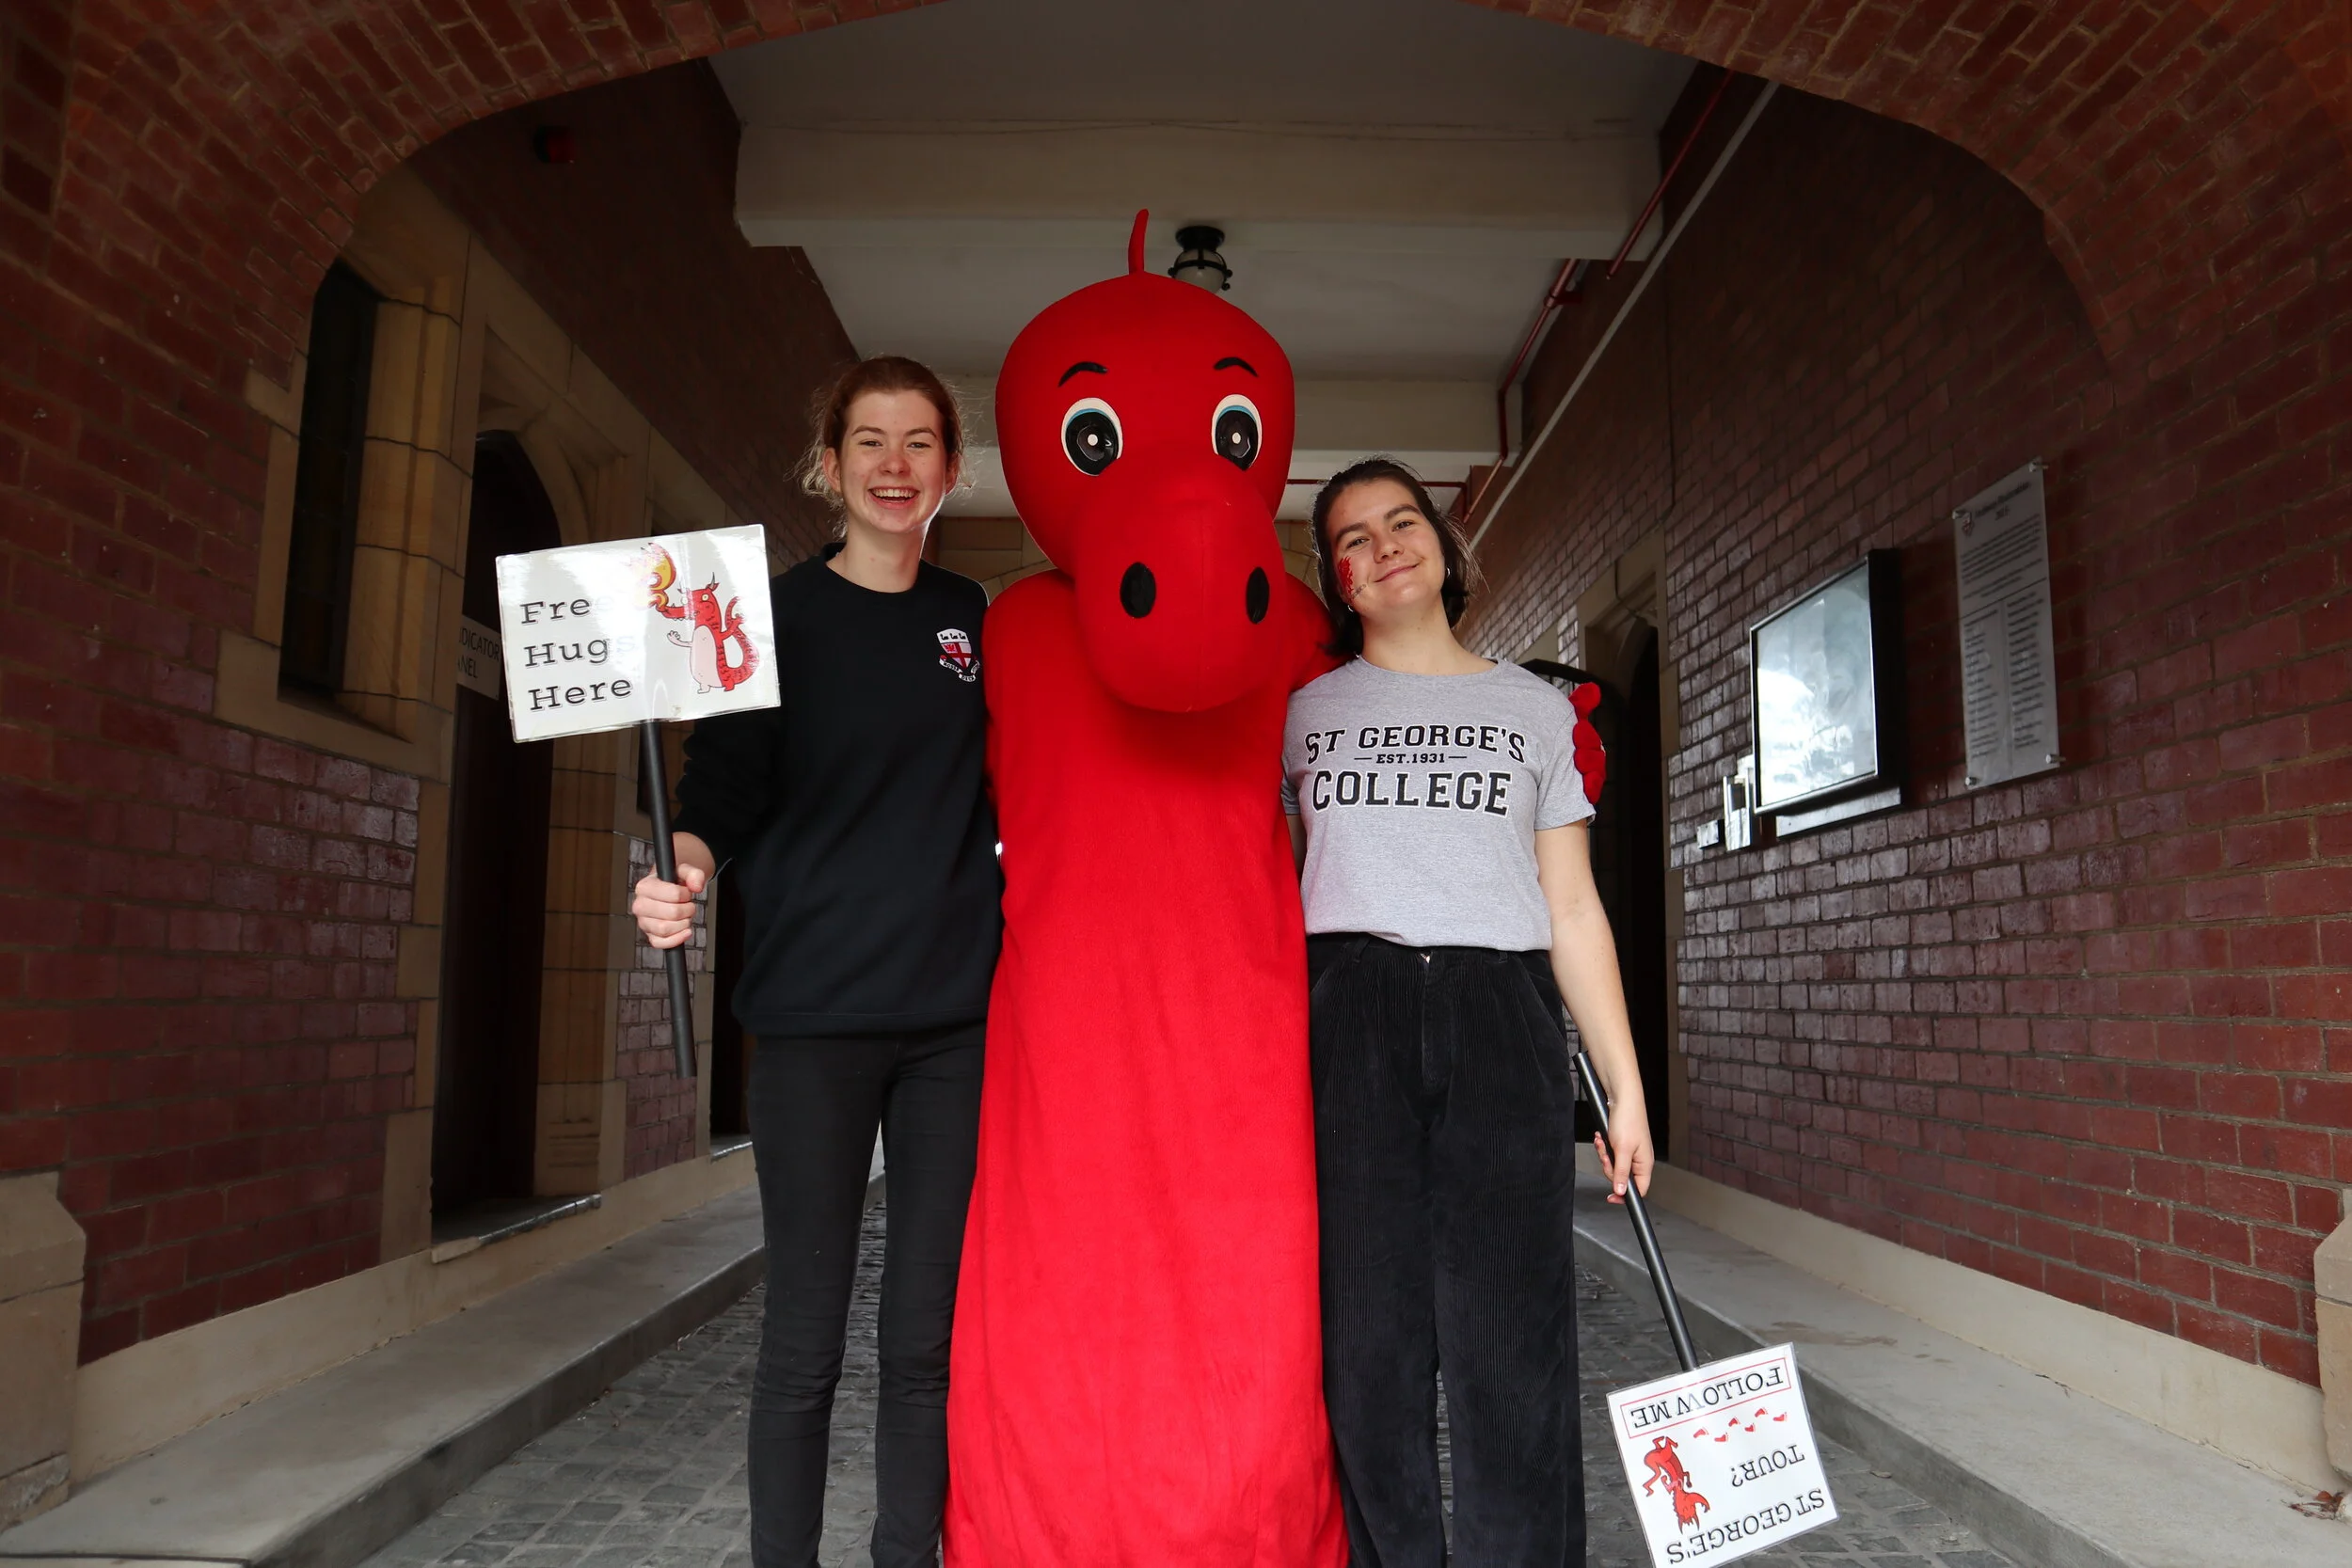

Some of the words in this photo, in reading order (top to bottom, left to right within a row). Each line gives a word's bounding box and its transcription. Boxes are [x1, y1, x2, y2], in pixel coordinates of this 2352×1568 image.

[528, 679, 632, 711] Here
[1304, 728, 1346, 765] ST
[1357, 724, 1526, 764] GEORGE'S
[1375, 752, 1446, 764] EST.1931
[1312, 769, 1512, 816] COLLEGE
[1677, 1367, 1784, 1416] FOLLOW
[1630, 1401, 1673, 1429] ME
[1730, 1444, 1805, 1488] TOUR?
[1796, 1488, 1825, 1516] ST
[1666, 1502, 1792, 1564] GEORGE'S
